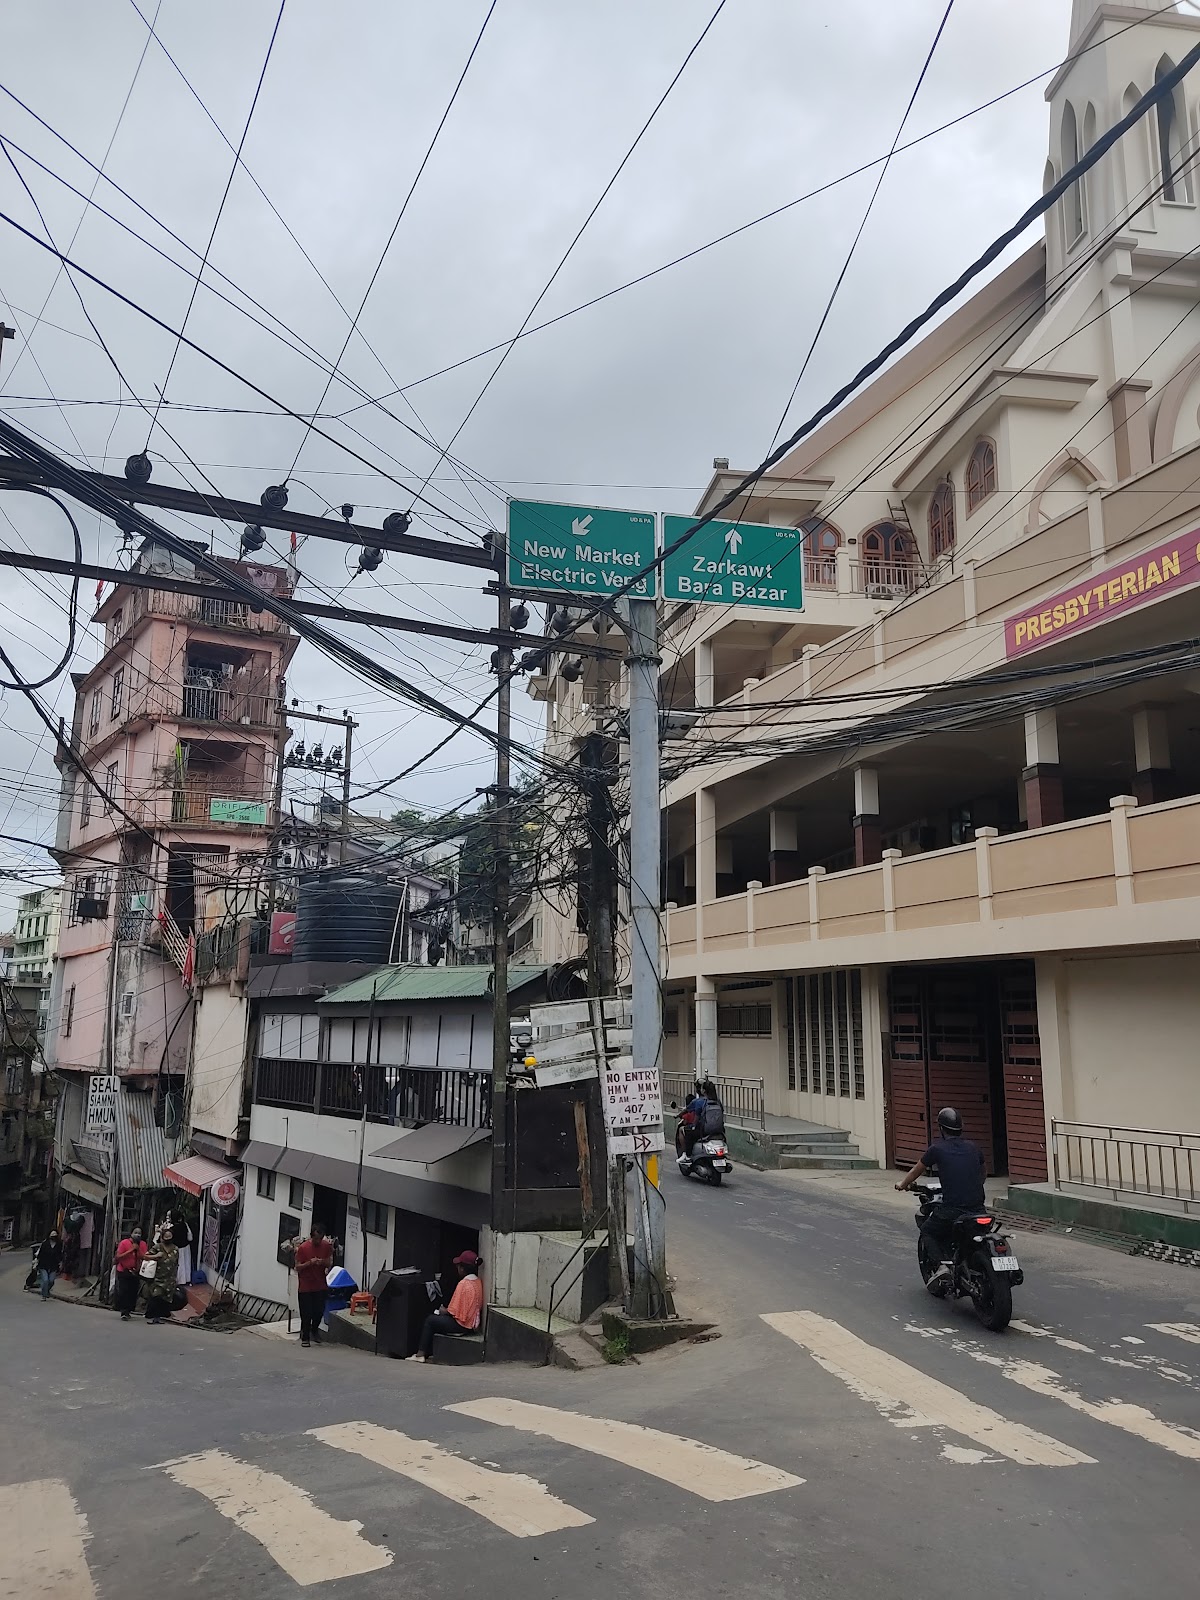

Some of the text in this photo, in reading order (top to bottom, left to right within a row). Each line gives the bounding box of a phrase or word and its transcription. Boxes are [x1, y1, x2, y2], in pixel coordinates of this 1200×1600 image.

[524, 540, 641, 567] New Market
[521, 563, 597, 586] Electric
[692, 556, 773, 579] Zarkawt
[678, 576, 788, 601] Bara Bazar
[1014, 550, 1181, 646] PRESBYTERIAN
[213, 801, 265, 813] ORIFLAME
[606, 1070, 657, 1083] NO ENTRY
[91, 1077, 118, 1093] SEAL
[607, 1082, 658, 1095] HMV MMV
[610, 1095, 616, 1103] 5
[640, 1093, 646, 1101] 9
[89, 1108, 115, 1123] HMUN
[624, 1104, 644, 1114] 407
[610, 1116, 616, 1125] 7
[619, 1116, 631, 1125] AM
[641, 1114, 647, 1122] 7
